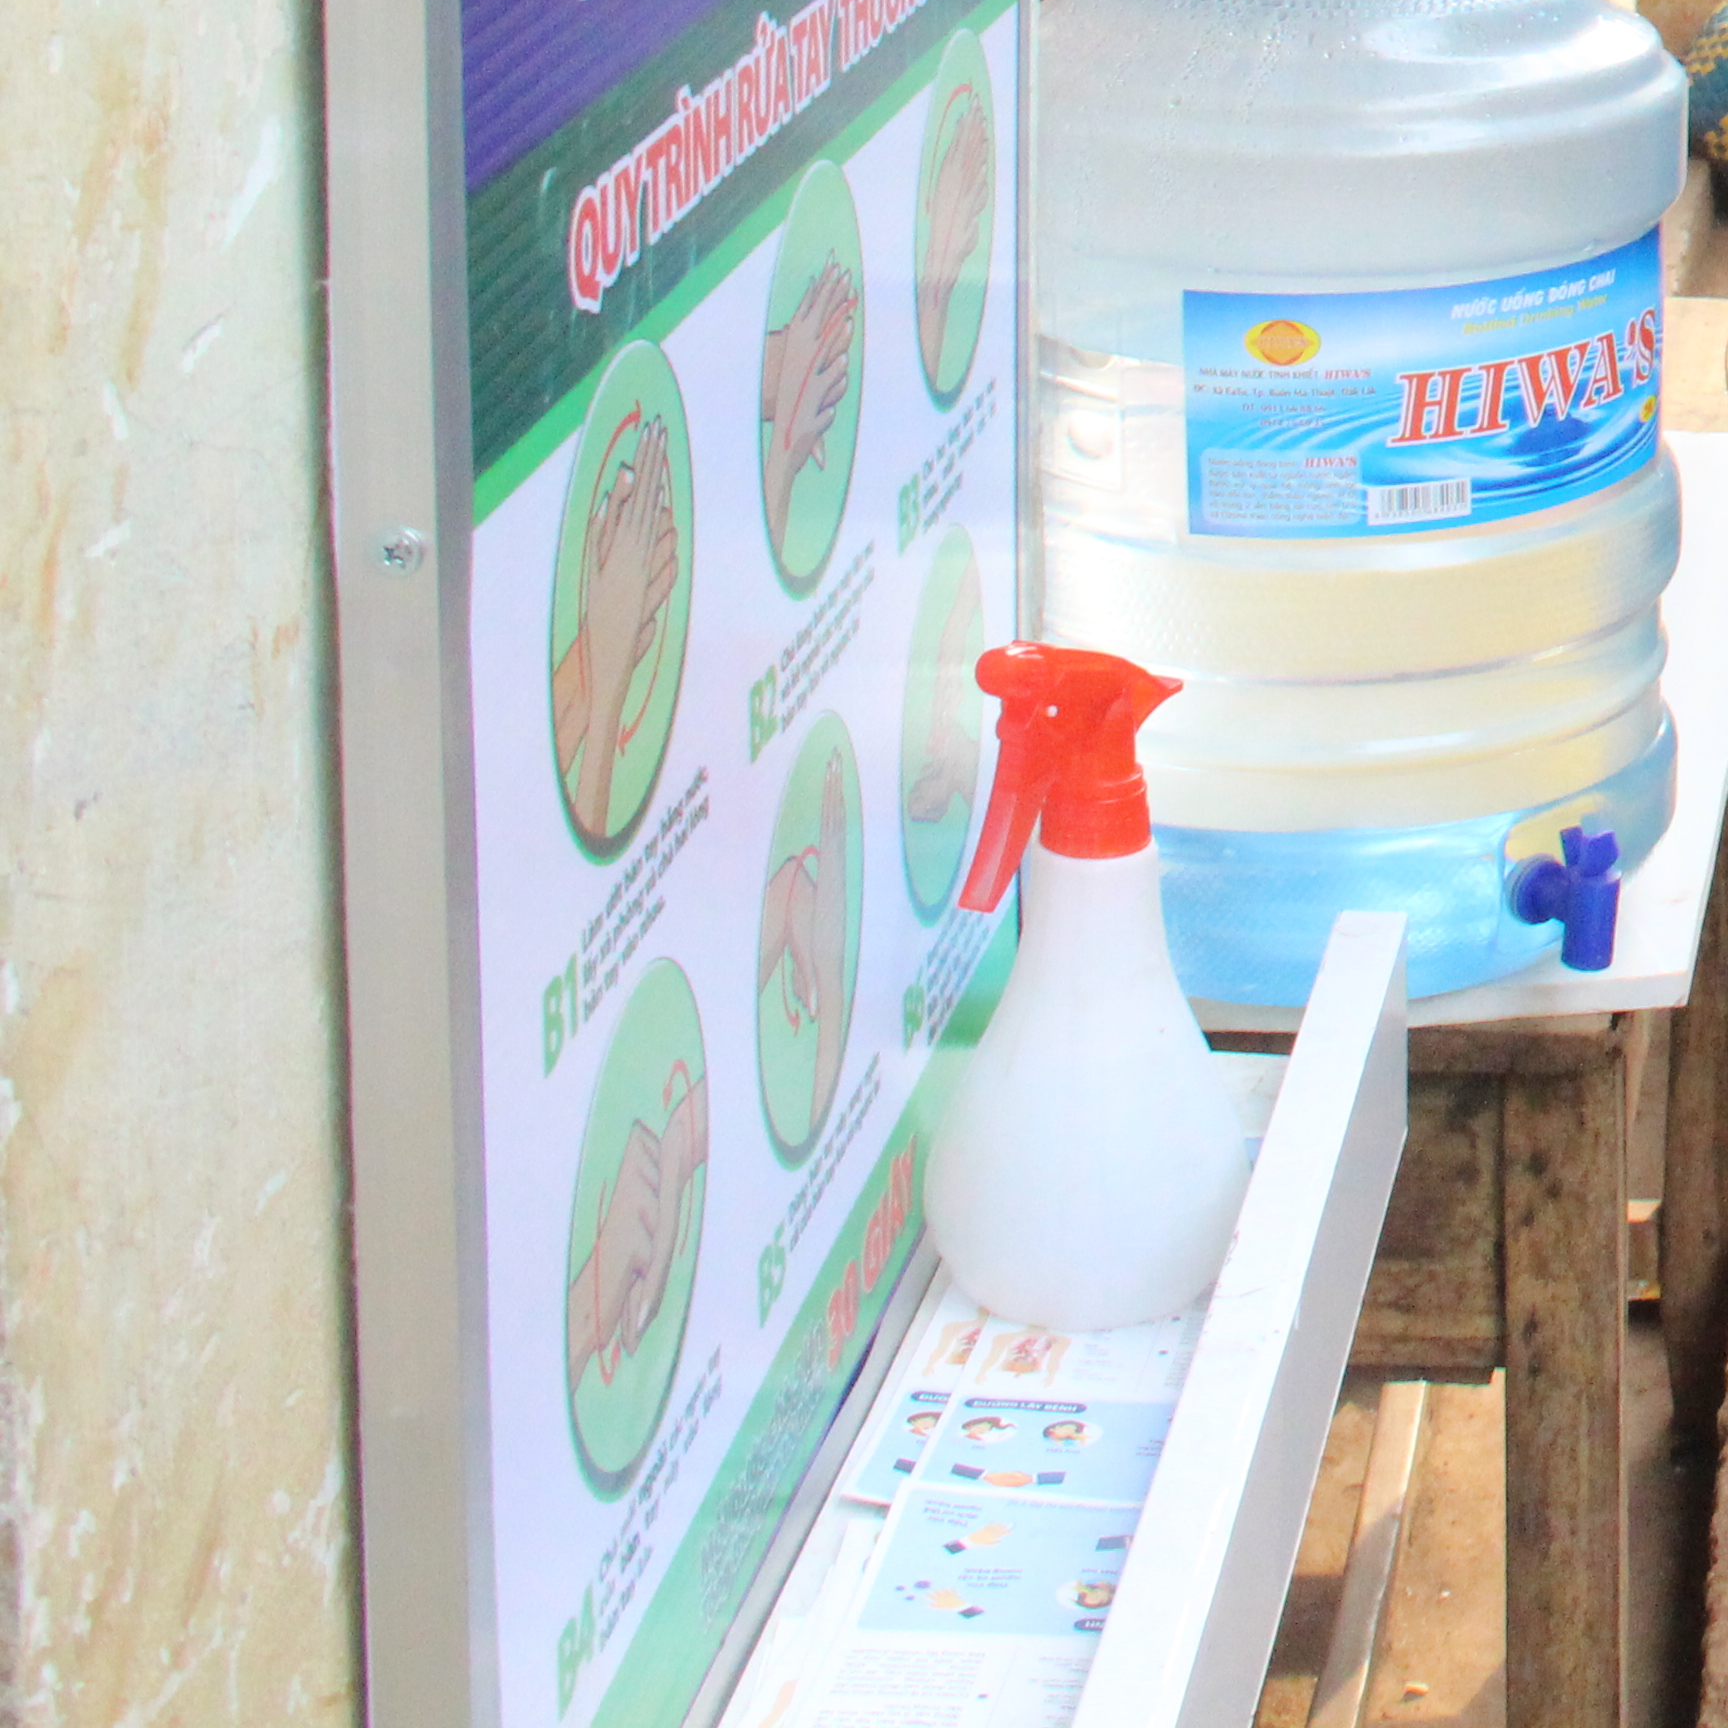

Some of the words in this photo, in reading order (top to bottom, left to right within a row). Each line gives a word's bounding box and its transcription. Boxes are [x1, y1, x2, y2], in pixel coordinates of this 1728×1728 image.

[568, 152, 645, 314] QUY
[642, 84, 735, 245] TRÌNH
[733, 11, 790, 175] RỬA
[1386, 307, 1657, 448] HIWA'S
[748, 663, 779, 766] B2
[541, 951, 579, 1079] B1
[557, 1581, 597, 1724] B4
